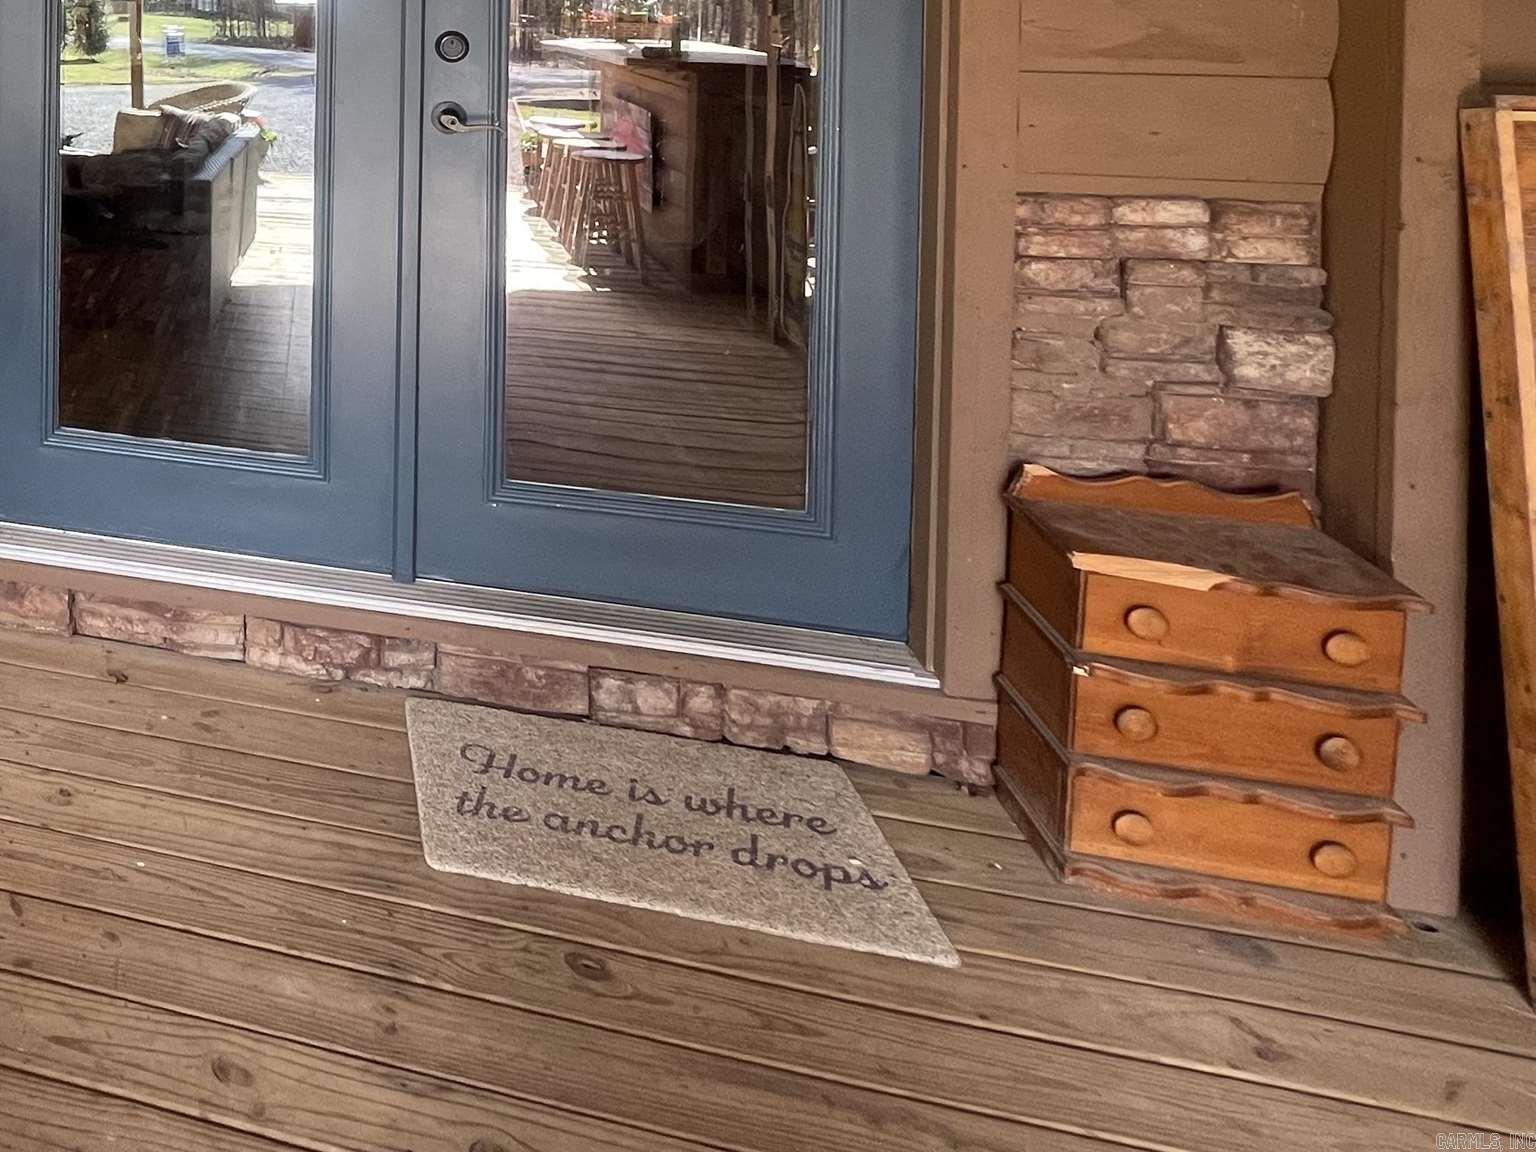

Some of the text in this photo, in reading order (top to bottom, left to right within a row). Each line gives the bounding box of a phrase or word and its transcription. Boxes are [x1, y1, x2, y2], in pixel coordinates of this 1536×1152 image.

[455, 785, 889, 891] the anchor drops
[459, 742, 837, 836] Home is where
